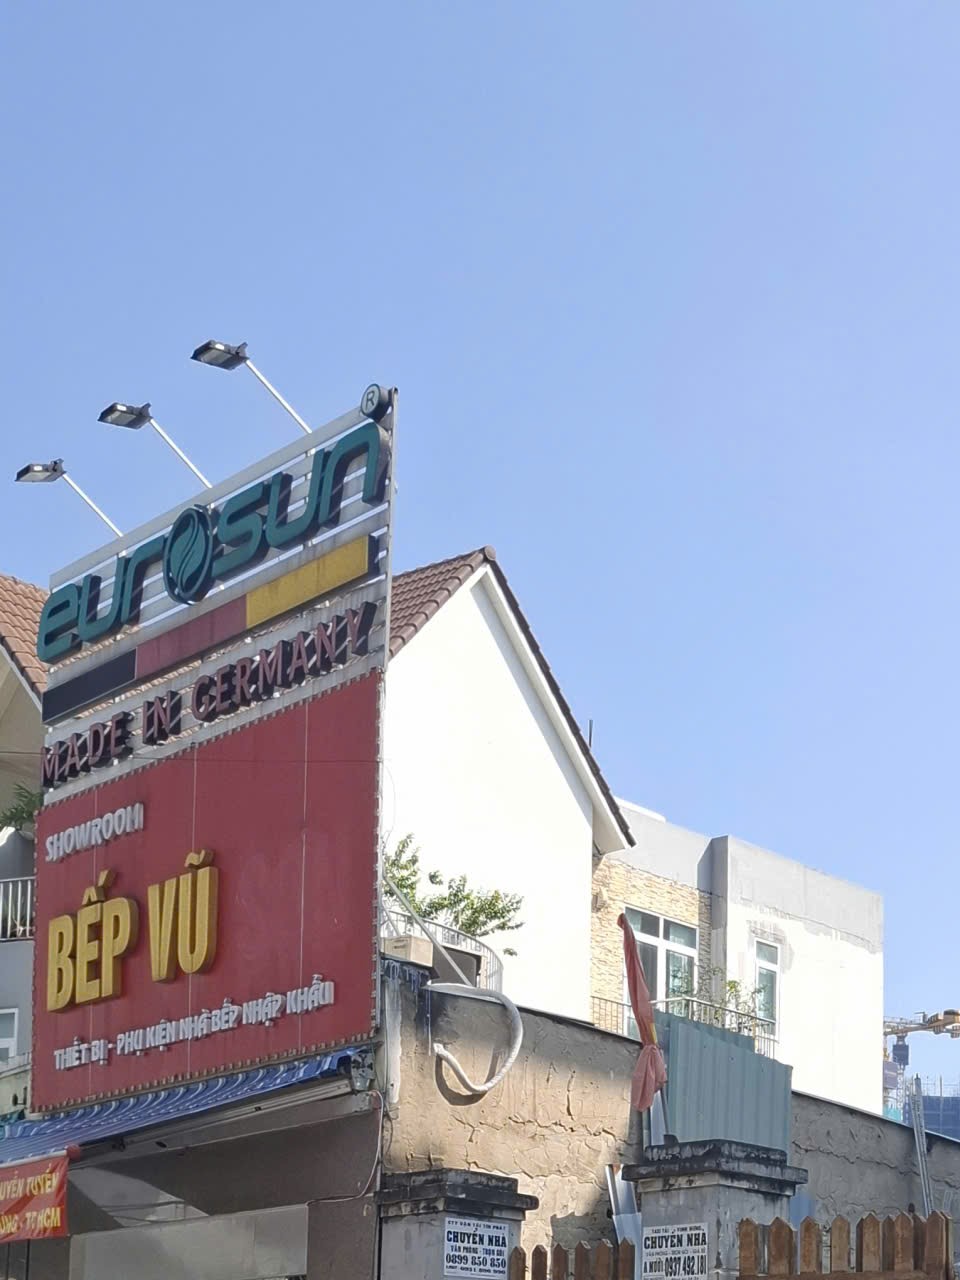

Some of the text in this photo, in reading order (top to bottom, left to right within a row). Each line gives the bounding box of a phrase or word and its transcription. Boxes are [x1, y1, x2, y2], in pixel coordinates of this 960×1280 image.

[41, 602, 376, 787] MADE IN GERMANY
[45, 803, 144, 862] SHOWROOM
[47, 848, 219, 1013] BẾP VŨ
[55, 1036, 89, 1070] THIẾT
[90, 1039, 109, 1064] BỊ
[116, 1029, 145, 1056] PHỤ
[146, 1019, 177, 1051] KIỆN
[180, 1008, 211, 1042] NHÀ
[211, 997, 242, 1032] BẾP
[242, 992, 286, 1027] NHẬP
[286, 973, 335, 1014] KHẨU
[446, 1227, 507, 1248] CHUYỂN NHÀ
[446, 1253, 507, 1269] 0899 850 850
